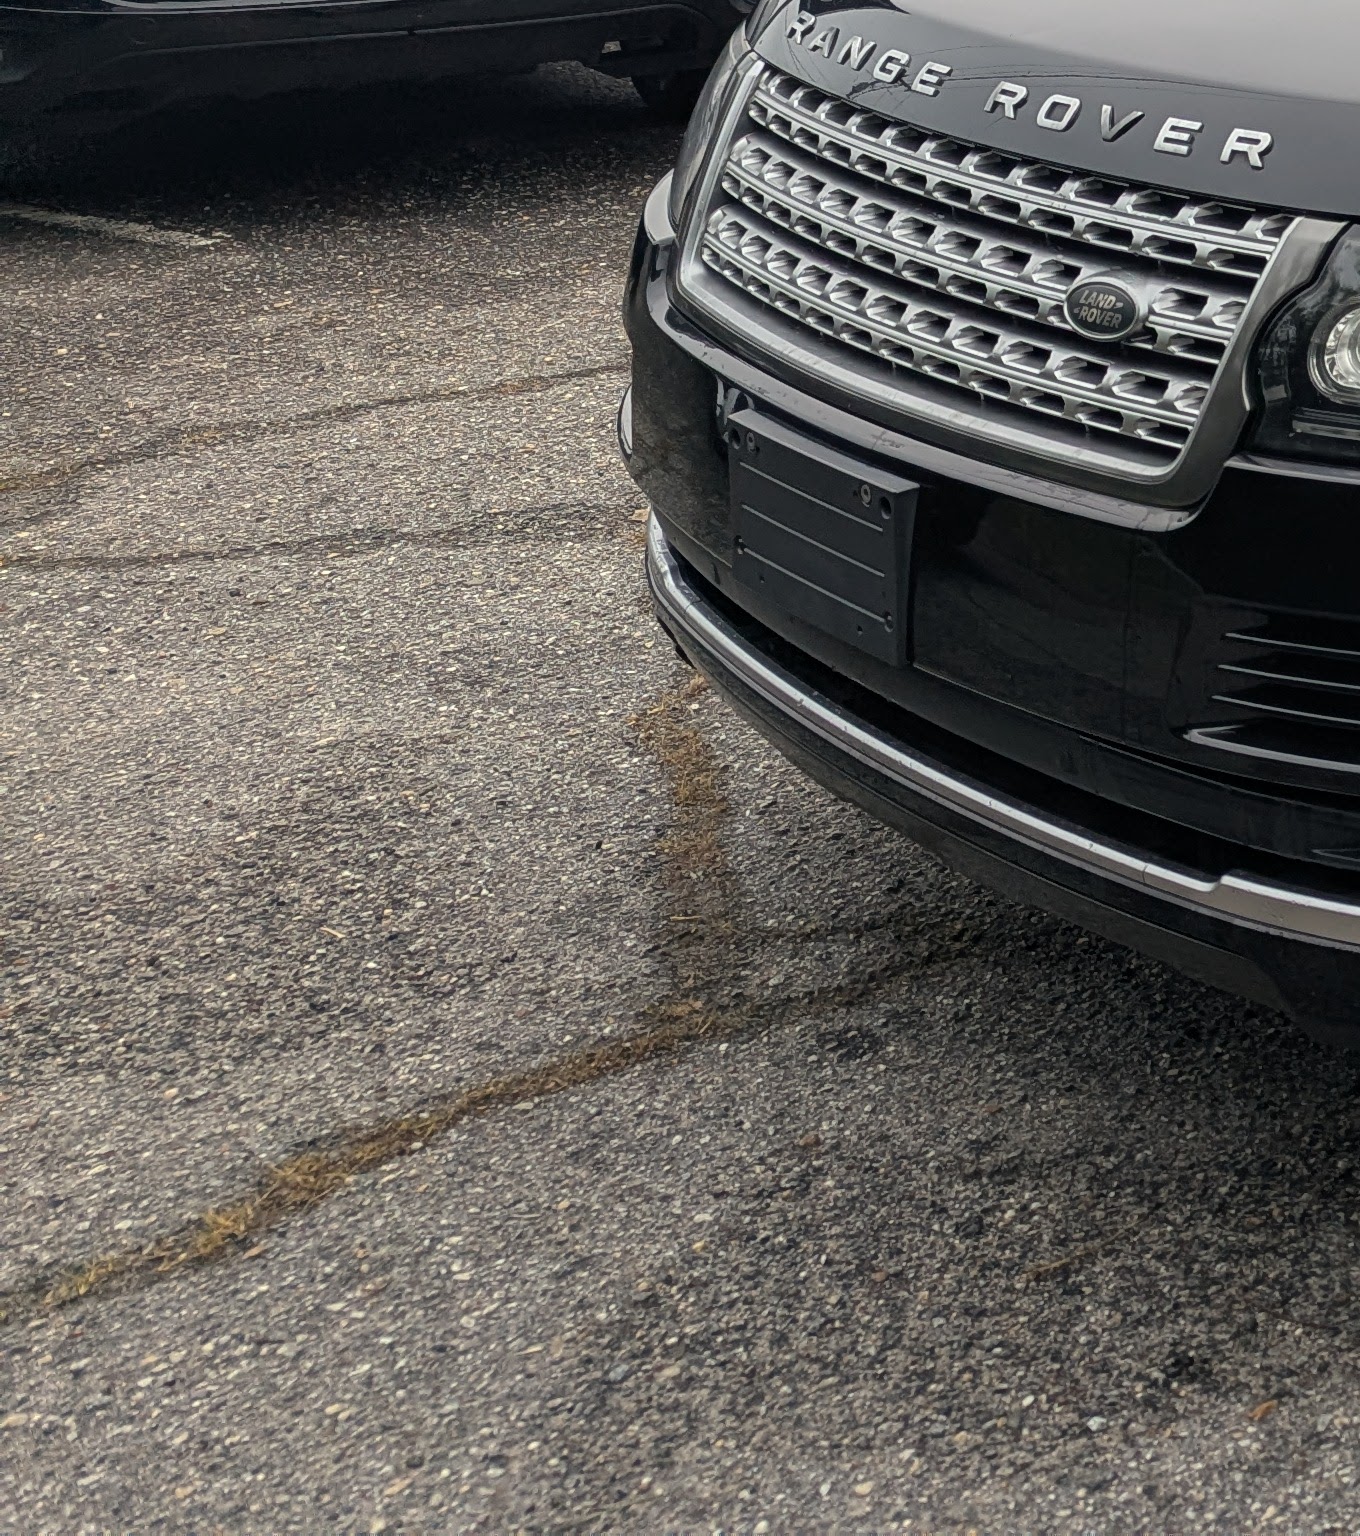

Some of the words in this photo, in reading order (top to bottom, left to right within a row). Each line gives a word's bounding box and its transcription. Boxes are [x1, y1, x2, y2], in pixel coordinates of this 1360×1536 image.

[784, 10, 952, 96] RANGE
[983, 80, 1274, 170] ROVER
[1079, 289, 1117, 309] LAND
[1078, 306, 1122, 328] ROVER
